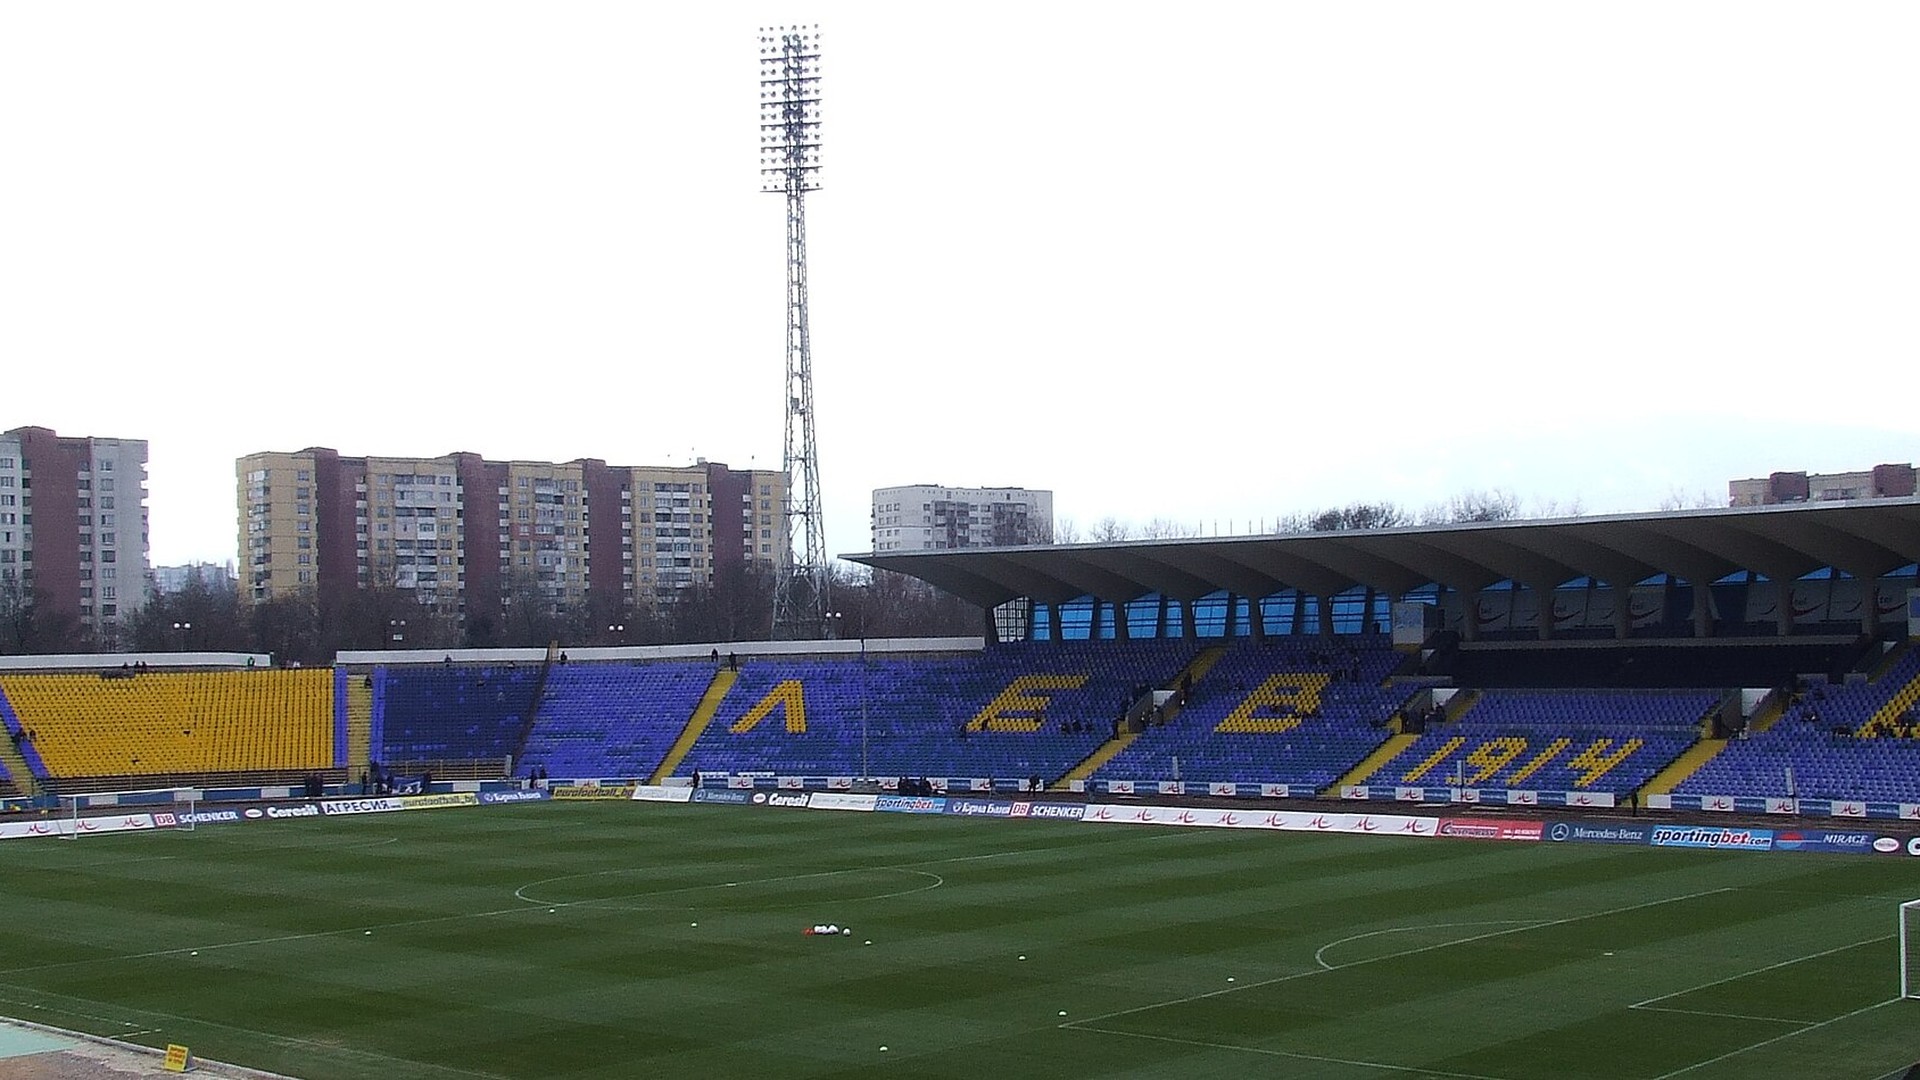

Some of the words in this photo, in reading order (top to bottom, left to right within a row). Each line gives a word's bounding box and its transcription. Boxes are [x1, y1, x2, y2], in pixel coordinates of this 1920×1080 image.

[1401, 737, 1645, 787] 1914
[769, 793, 808, 807] Ceresit
[267, 804, 319, 818] Ceresit
[326, 801, 391, 814] АГРЕСИЯ
[1012, 803, 1028, 815] DB
[1031, 805, 1084, 818] SCHENKER
[156, 814, 175, 825] DB
[179, 811, 238, 824] SCHENKER
[1573, 827, 1643, 840] Mercedes-Benz
[1653, 828, 1771, 847] sportingbet.com
[1823, 834, 1868, 845] MIRAGE
